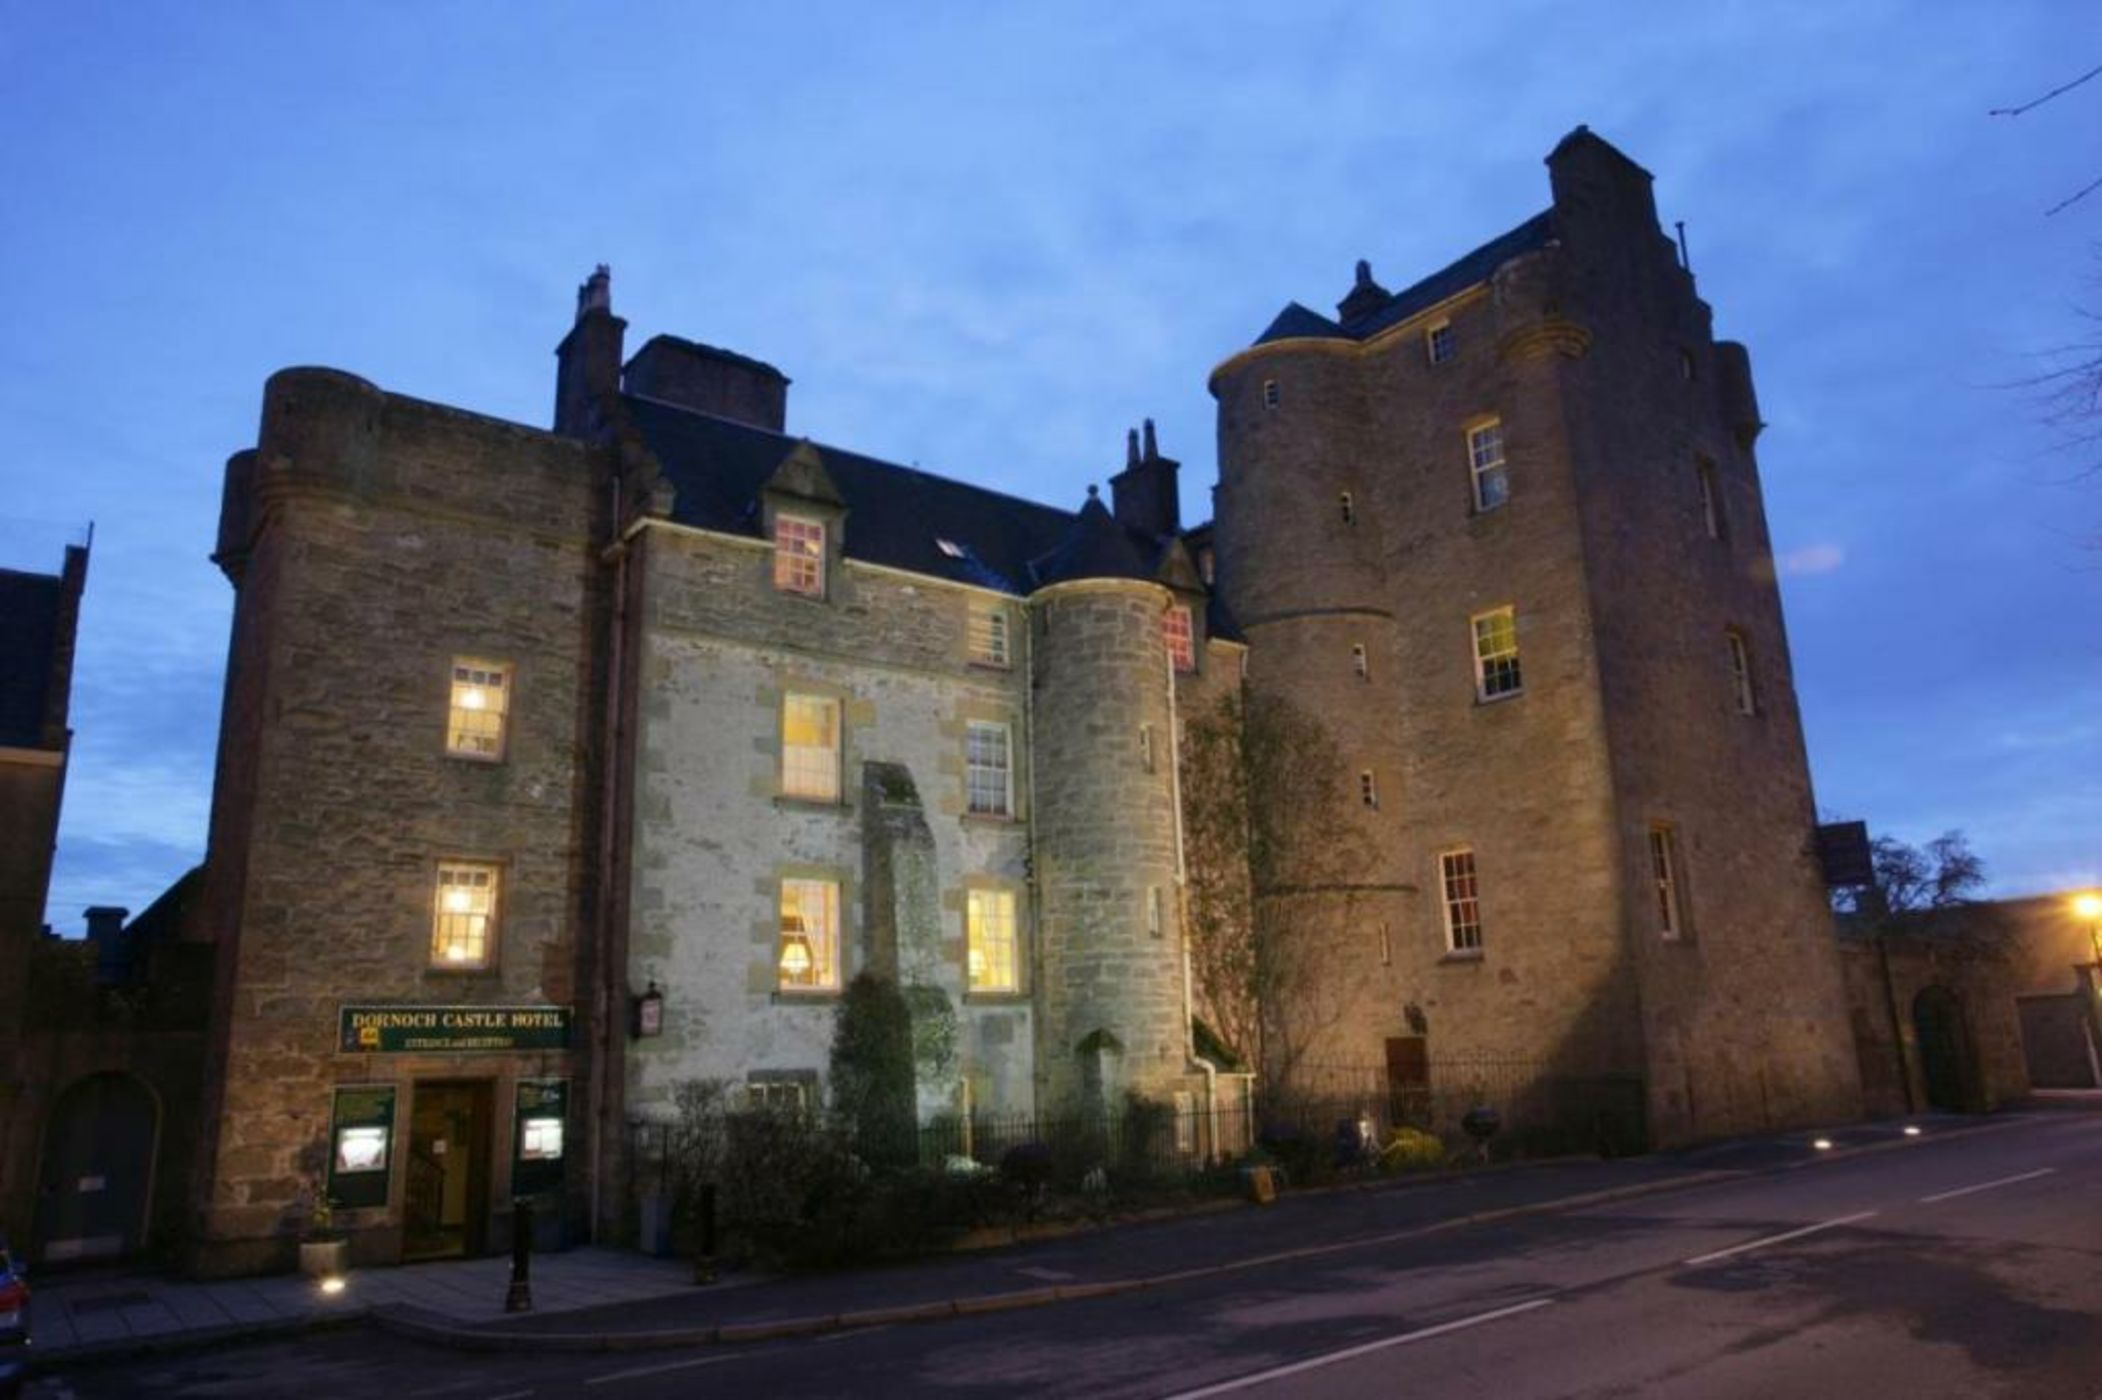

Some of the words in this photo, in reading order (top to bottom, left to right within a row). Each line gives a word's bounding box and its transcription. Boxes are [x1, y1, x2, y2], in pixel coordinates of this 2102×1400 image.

[352, 1012, 436, 1028] DORNOCH
[442, 1012, 506, 1028] CASTLE
[512, 1012, 564, 1028] HOTEL
